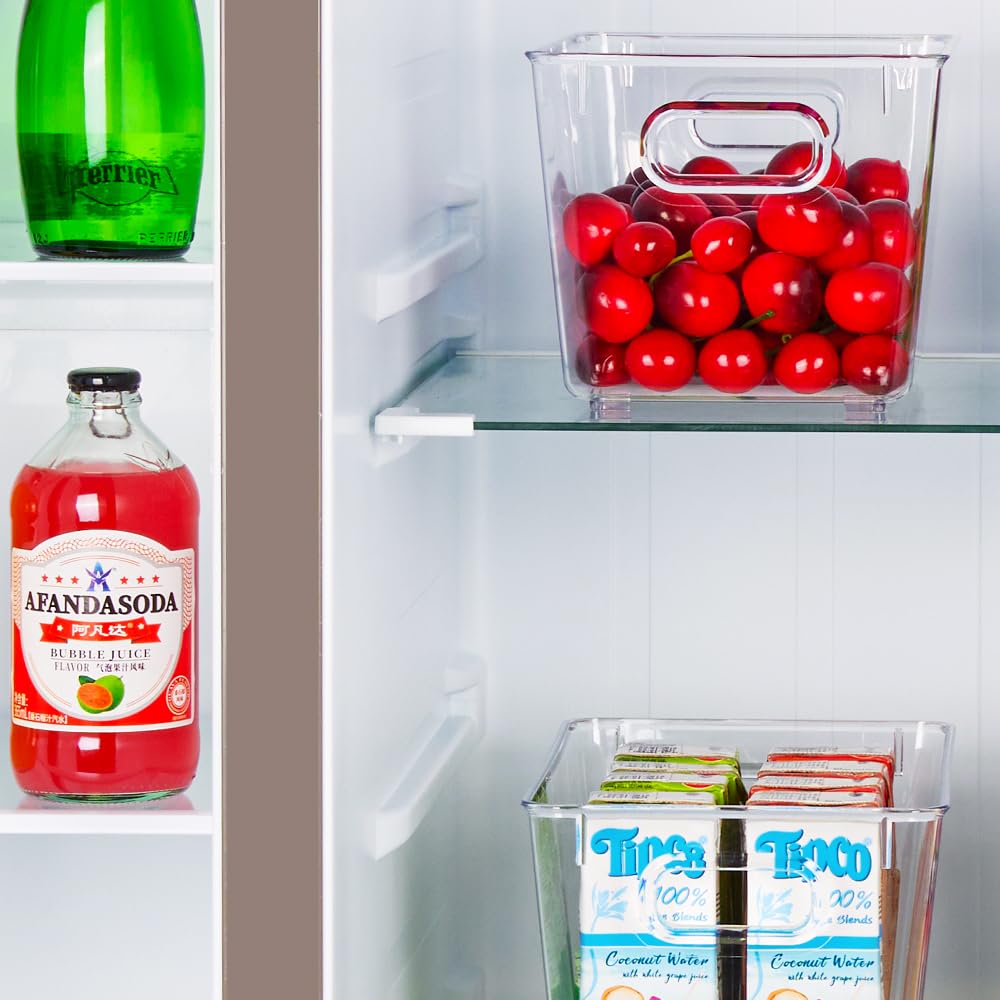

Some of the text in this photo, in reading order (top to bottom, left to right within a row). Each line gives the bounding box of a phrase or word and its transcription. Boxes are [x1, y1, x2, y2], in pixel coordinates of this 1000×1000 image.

[25, 591, 178, 615] AFANDASODA
[71, 623, 127, 637] 阿凡达
[51, 648, 151, 661] BUBBLE JUICE
[54, 661, 89, 672] FLAVOR
[829, 888, 873, 910] 00%
[836, 914, 873, 924] Blends
[605, 950, 709, 966] Coconut Water
[770, 953, 875, 970] Coconut Water
[622, 969, 638, 978] with
[642, 969, 662, 978] white
[664, 973, 687, 984] grape
[787, 972, 803, 981] with
[807, 972, 828, 981] white
[829, 975, 853, 987] grape
